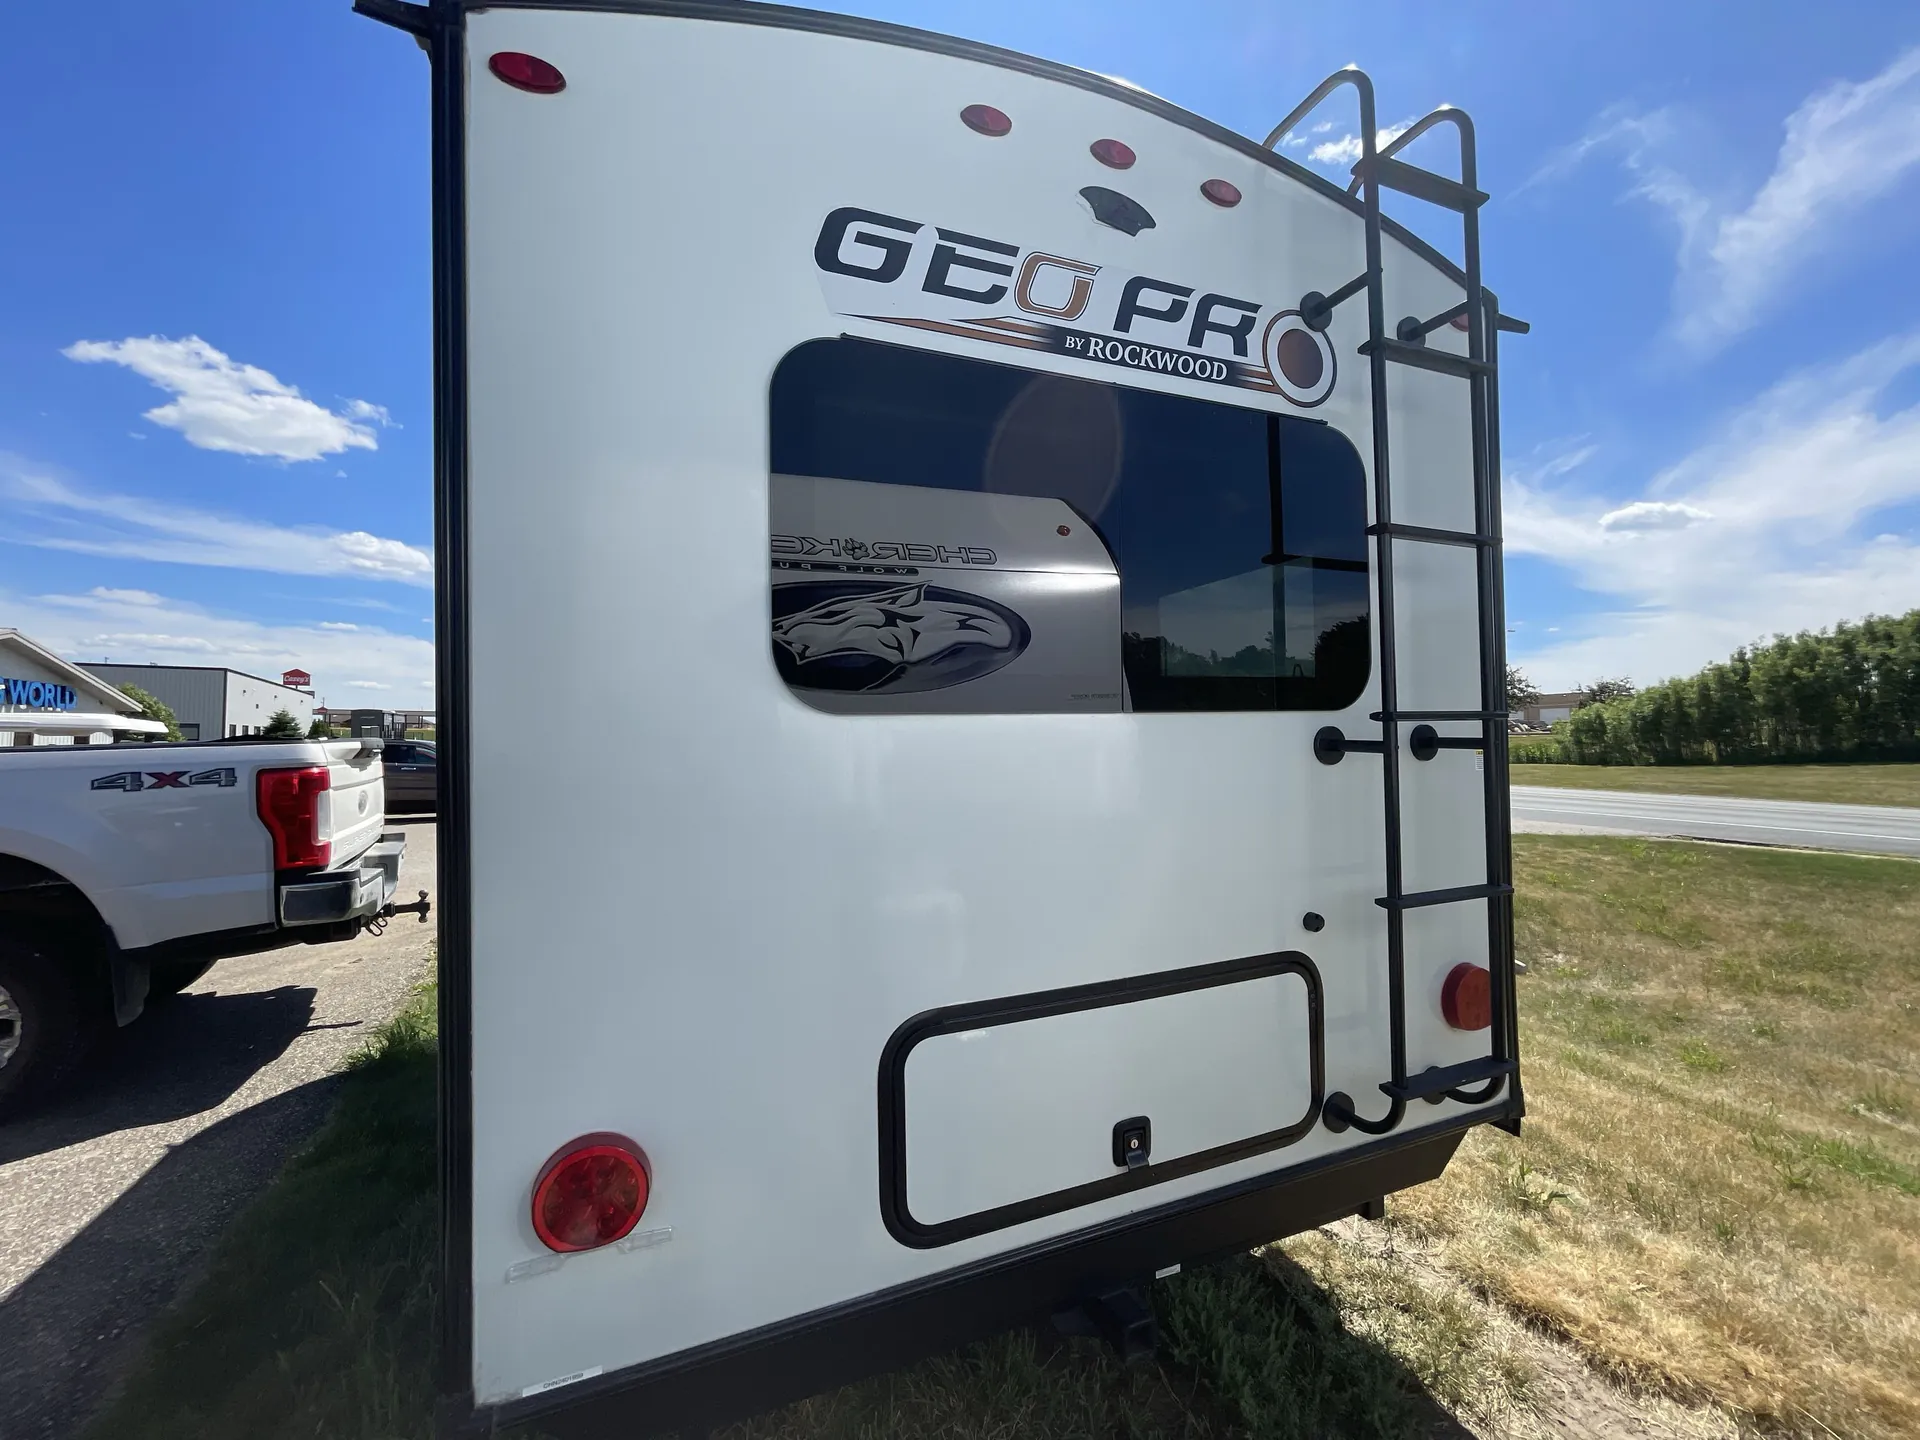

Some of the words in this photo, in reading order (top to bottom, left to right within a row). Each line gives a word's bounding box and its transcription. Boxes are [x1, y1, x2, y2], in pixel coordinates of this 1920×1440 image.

[814, 206, 1102, 322] GEO
[1113, 275, 1337, 409] PRO
[1065, 335, 1085, 351] BY
[1087, 337, 1228, 382] ROCKWOOD
[9, 678, 78, 710] WORLD
[284, 675, 310, 684] Casey's
